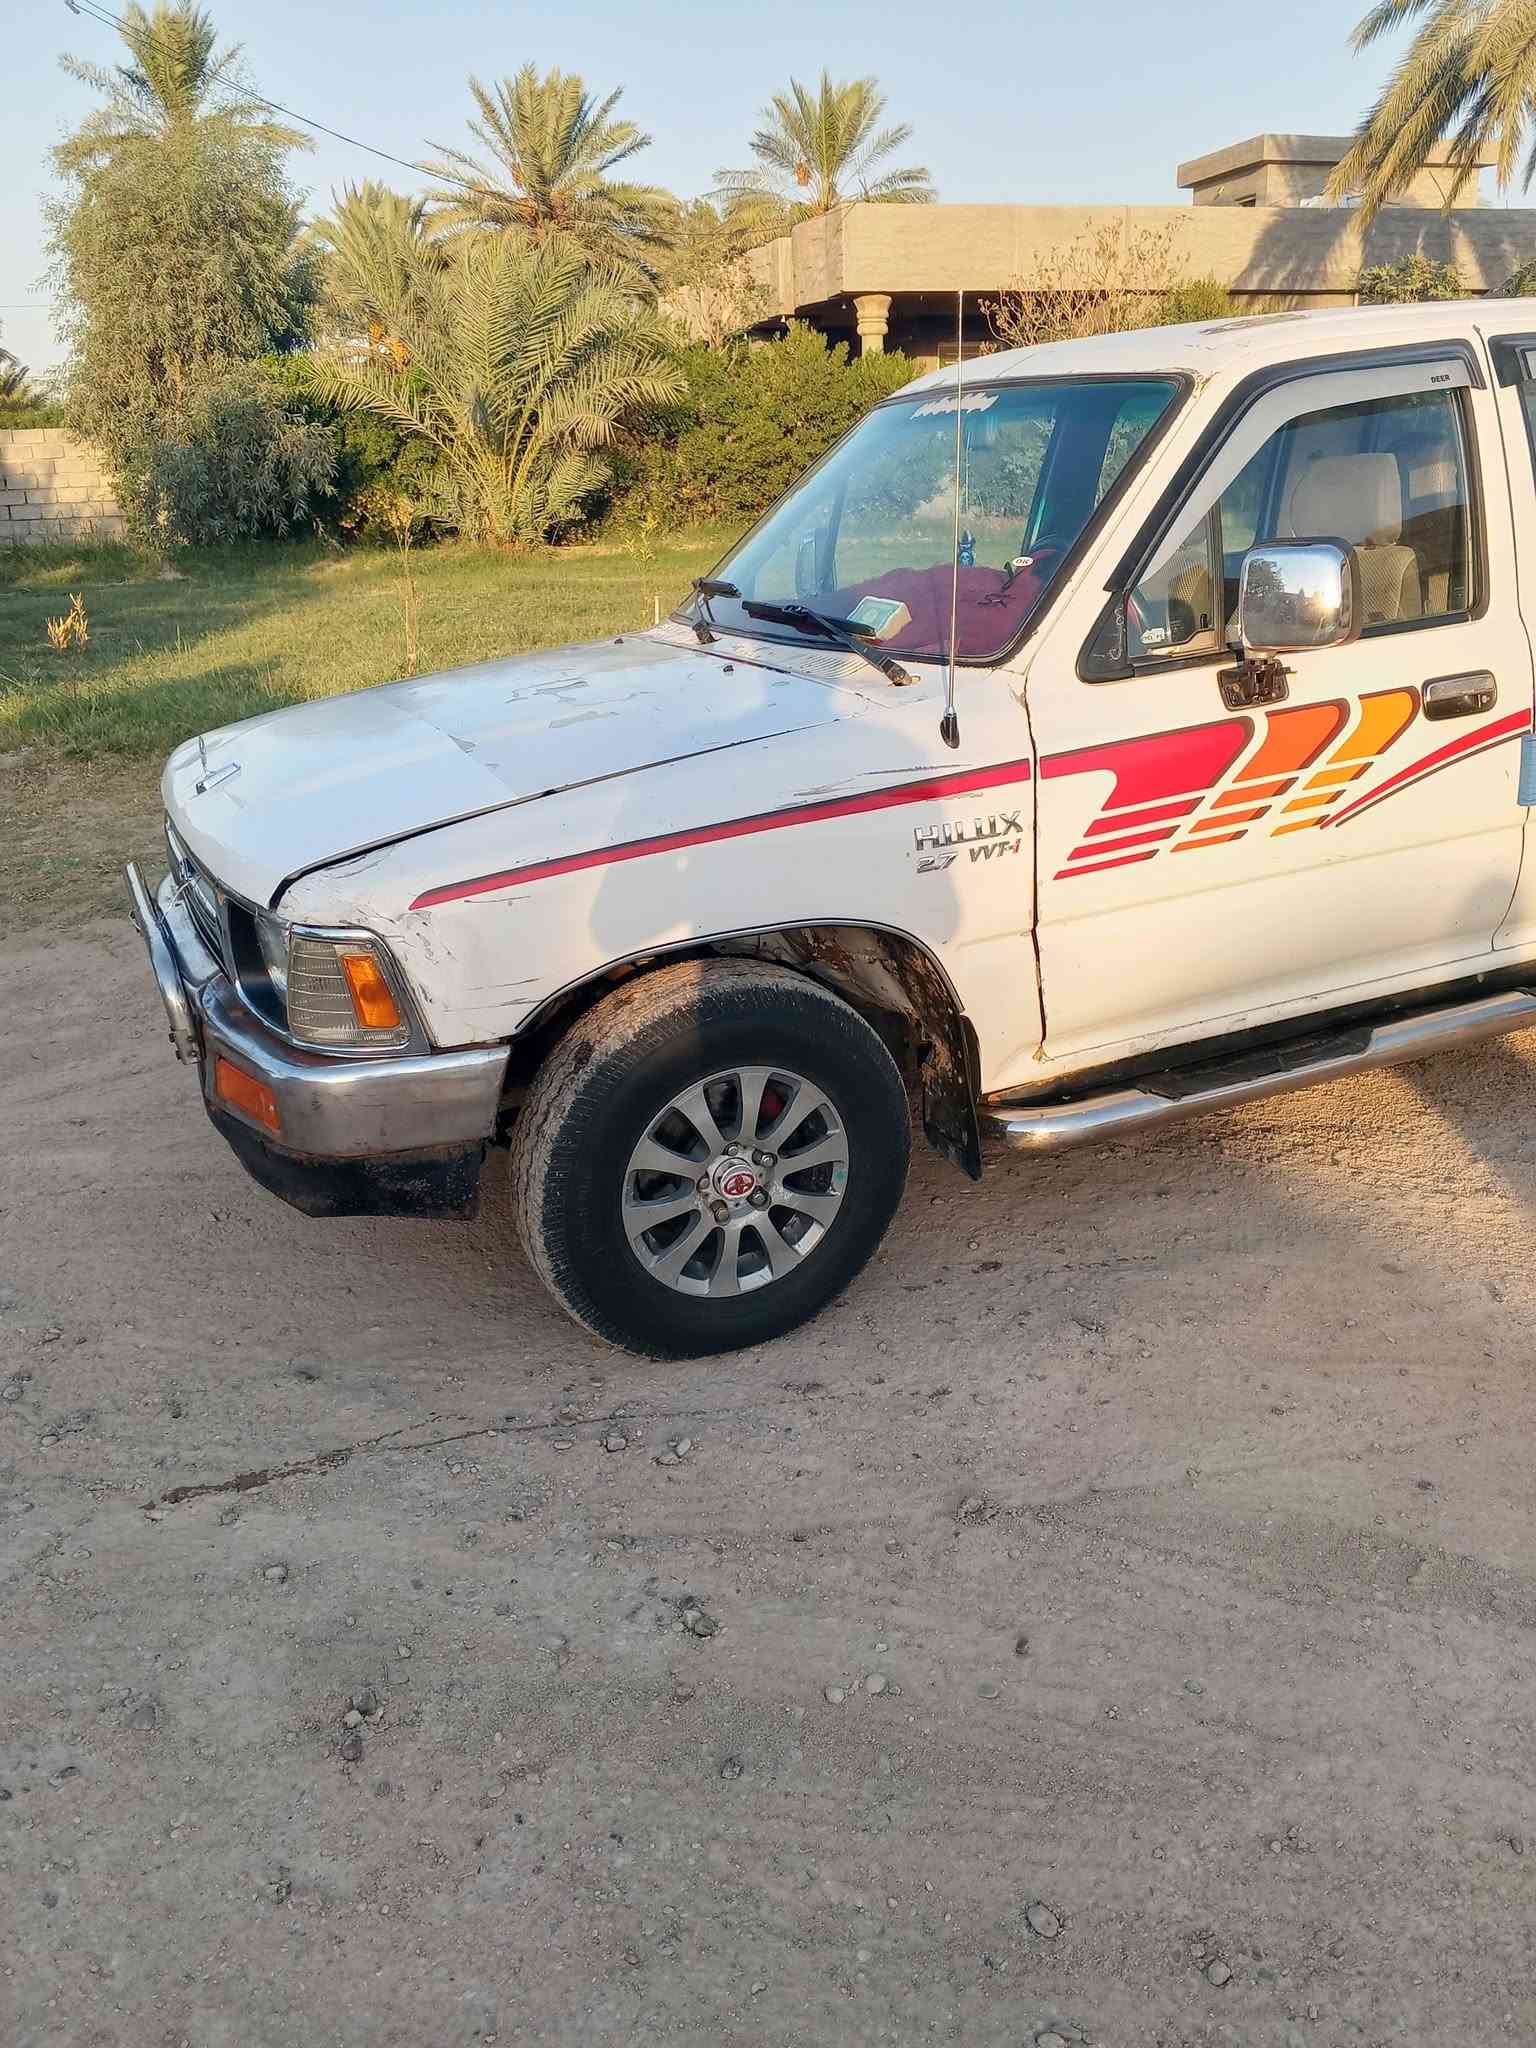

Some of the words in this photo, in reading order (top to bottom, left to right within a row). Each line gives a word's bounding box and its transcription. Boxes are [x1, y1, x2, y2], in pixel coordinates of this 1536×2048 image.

[1430, 374, 1451, 384] DEER
[914, 810, 1023, 851] HILUX
[968, 838, 1022, 863] VVT-i
